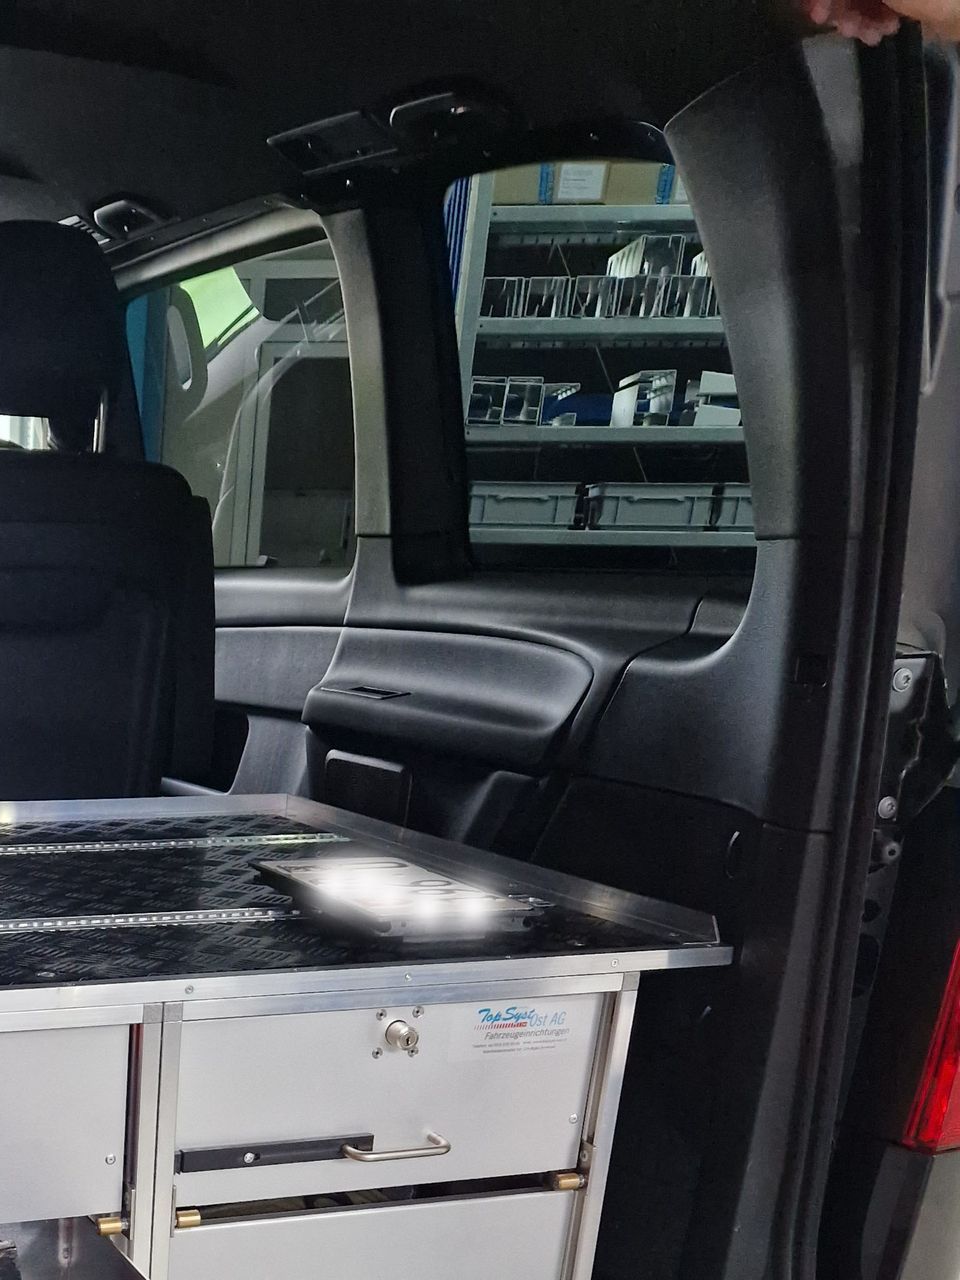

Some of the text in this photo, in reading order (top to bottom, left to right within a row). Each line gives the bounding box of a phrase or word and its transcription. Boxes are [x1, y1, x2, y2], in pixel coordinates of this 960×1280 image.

[529, 1012, 548, 1027] Ost
[549, 1011, 567, 1026] AG
[484, 1027, 570, 1041] Fahrzeugeinrichtungen
